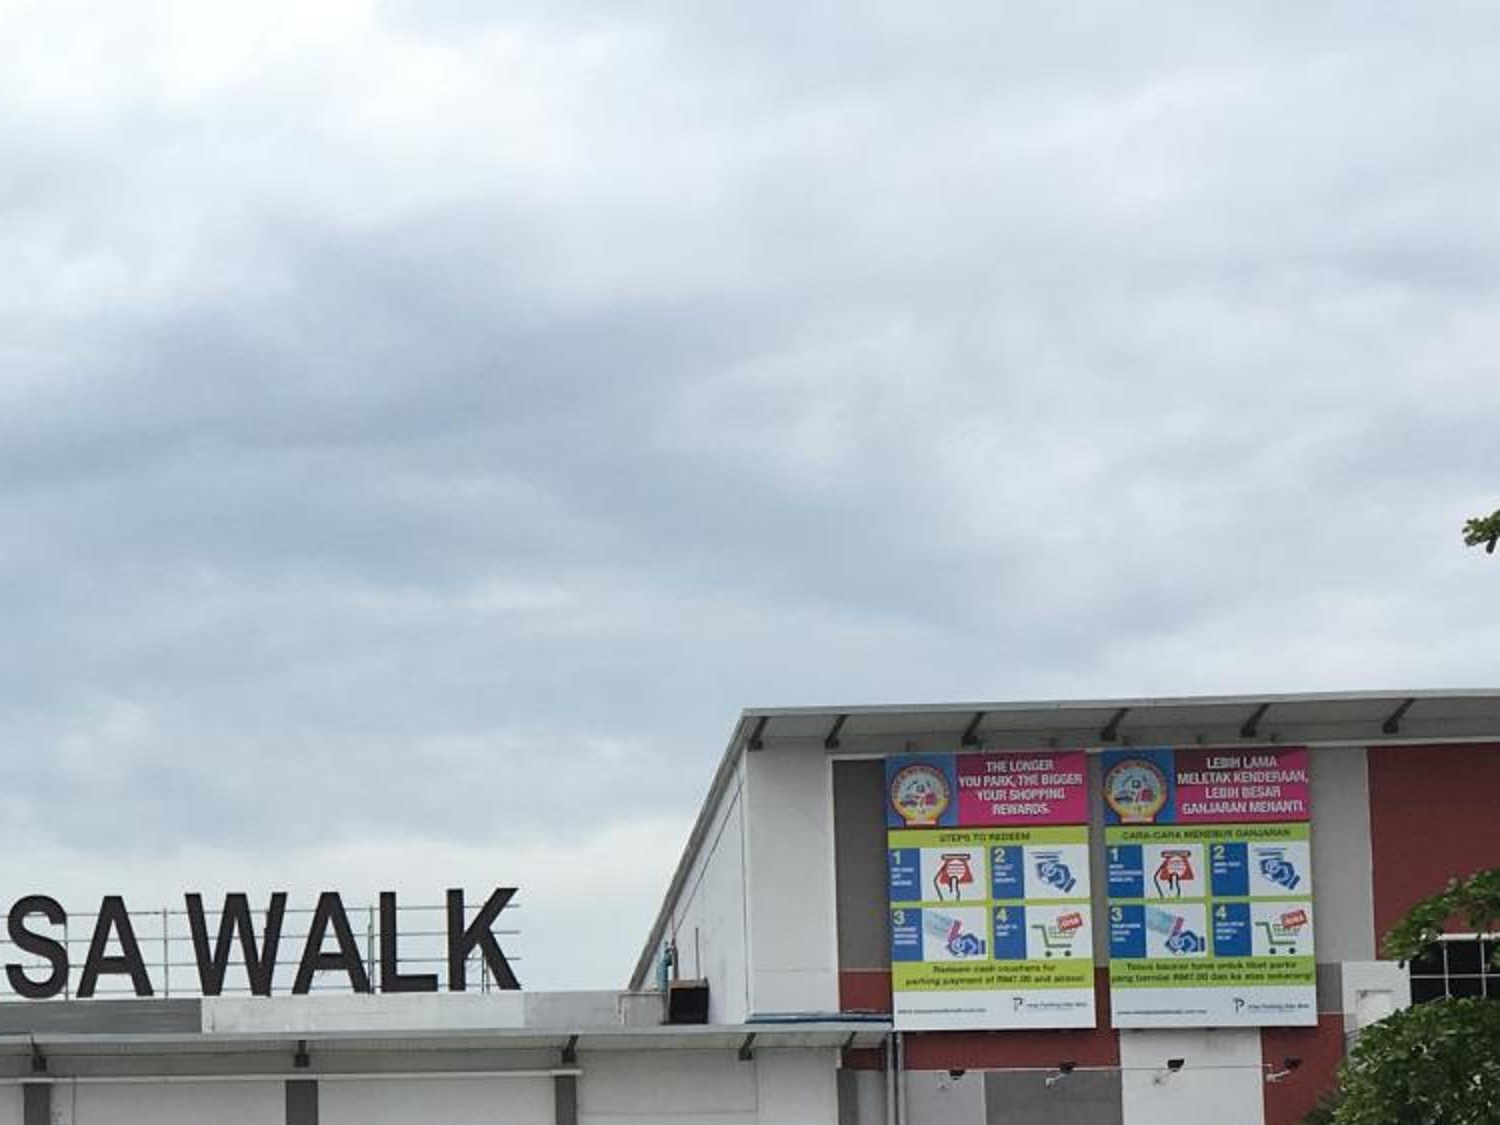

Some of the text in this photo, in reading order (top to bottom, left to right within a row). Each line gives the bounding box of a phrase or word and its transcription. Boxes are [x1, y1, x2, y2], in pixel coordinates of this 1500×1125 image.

[986, 758, 1053, 773] THE LONGER
[1206, 755, 1277, 769] LEBIH LAMA
[960, 772, 1083, 788] YOU PARK, THE BIGGER
[1177, 770, 1309, 785] MELETAK KENDERAAN,
[977, 787, 1066, 801] YOUR SHOPPING
[1205, 786, 1281, 800] LEBIH BESAR
[1183, 801, 1247, 815] GANJARAN
[938, 831, 1031, 843] STEPS TO REDEEM
[891, 851, 901, 865] 1
[994, 848, 1005, 863] 2
[1110, 848, 1119, 862] 1
[1213, 845, 1225, 860] 2
[893, 910, 905, 925] 3
[996, 908, 1008, 923] 4
[1111, 906, 1123, 921] 3
[1215, 905, 1227, 920] 4
[185, 887, 522, 997] WALK
